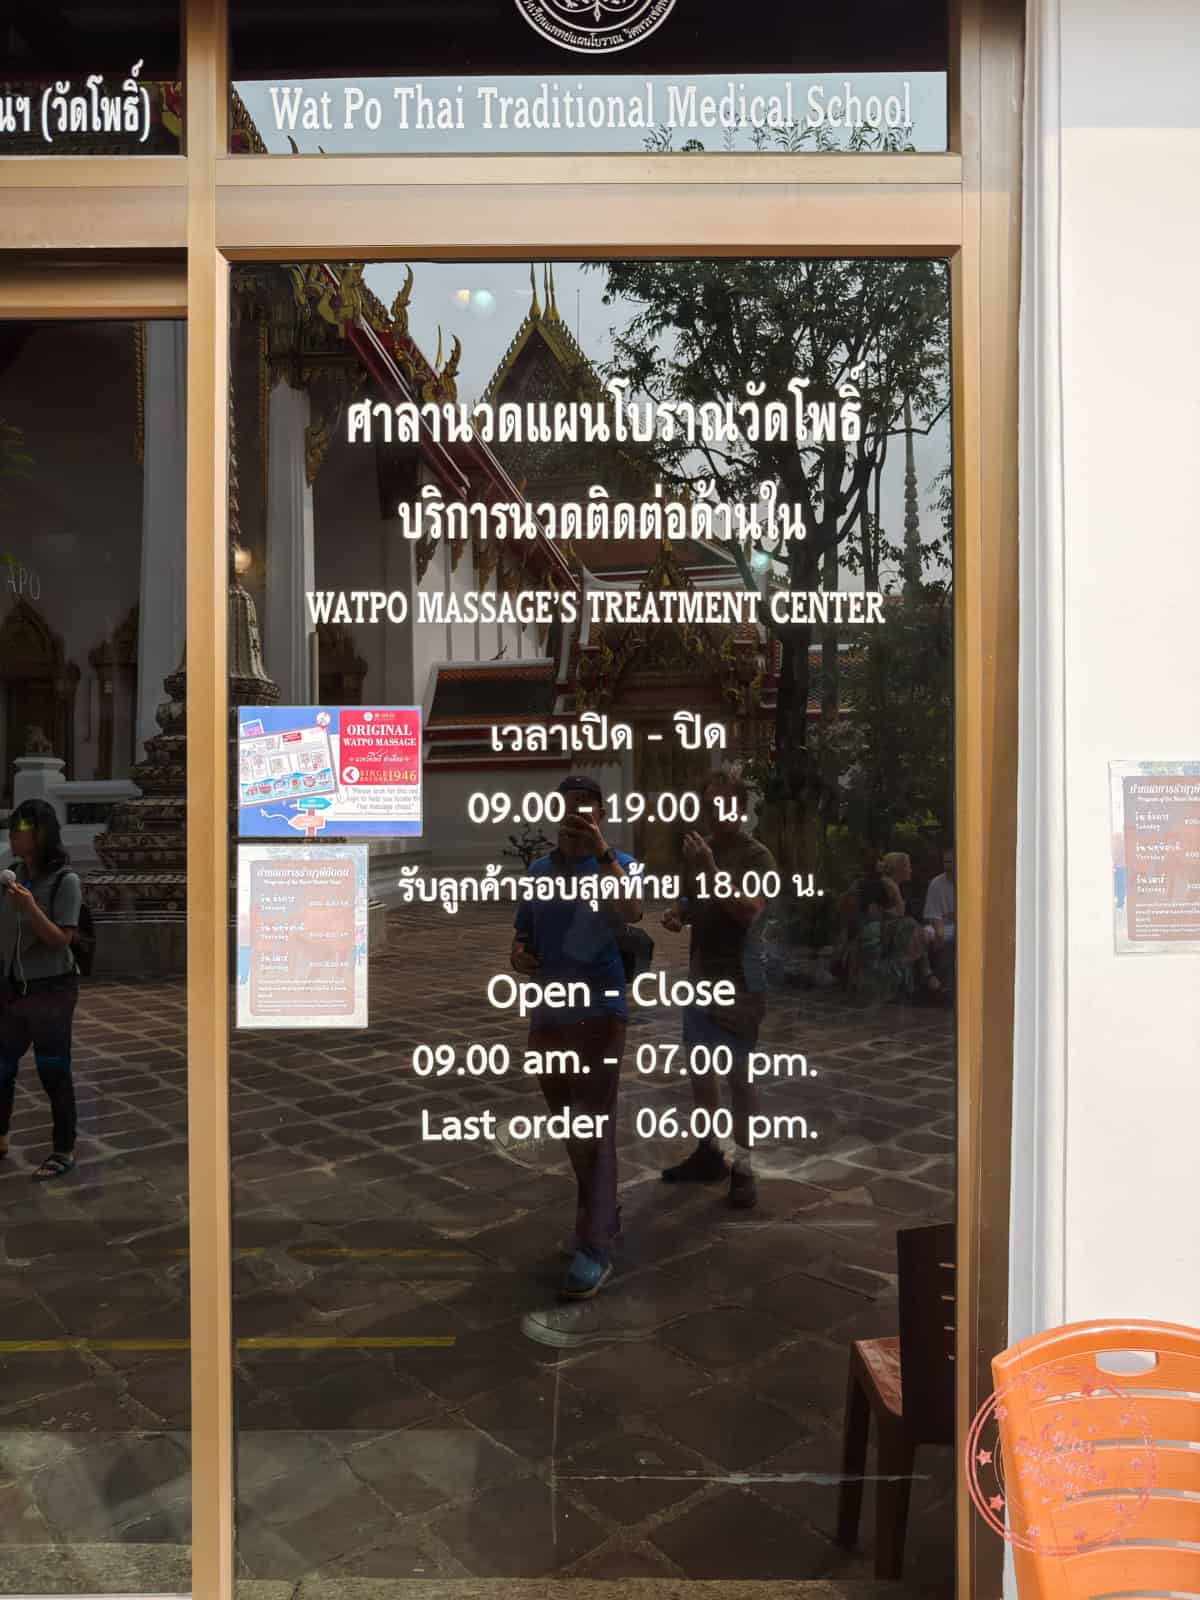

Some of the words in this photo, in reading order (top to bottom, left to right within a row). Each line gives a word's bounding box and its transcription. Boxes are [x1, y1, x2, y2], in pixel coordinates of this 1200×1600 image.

[41, 58, 150, 142] (วัดโพธิ์)
[269, 86, 333, 129] Wat
[343, 86, 383, 129] Po
[393, 83, 465, 129] Thai
[477, 82, 655, 129] Traditional
[667, 81, 794, 128] Medical
[807, 81, 912, 128] School
[346, 361, 864, 444] ศาลานวดแผนโบราณวัดโพธิ์
[398, 480, 807, 542] บริการนวดติดต่อด้านใน
[305, 591, 408, 625] WATPO
[586, 591, 762, 625] TREATMENT
[771, 590, 885, 625] CENTER
[343, 737, 374, 747] WATPO
[375, 737, 417, 747] MASSAGE
[346, 723, 413, 736] ORIGINAL
[491, 711, 633, 752] เวลาเปิด
[673, 711, 727, 750] ปิด
[467, 791, 566, 824] 09.00
[606, 791, 700, 823] 19.00
[713, 795, 749, 822] น.
[398, 862, 680, 914] รับลูกค้ารอบสุดท้าย
[695, 870, 781, 898] 18.00
[792, 873, 825, 897] น.
[487, 973, 591, 1017] Open
[632, 971, 736, 1007] Close
[412, 1043, 510, 1076] 09.00
[523, 1050, 590, 1074] am.
[636, 1043, 733, 1075] 07.00
[748, 1051, 818, 1083] pm.
[421, 1108, 496, 1141] Last
[508, 1106, 609, 1140] order
[636, 1107, 733, 1140] 06.00
[748, 1114, 818, 1147] pm.
